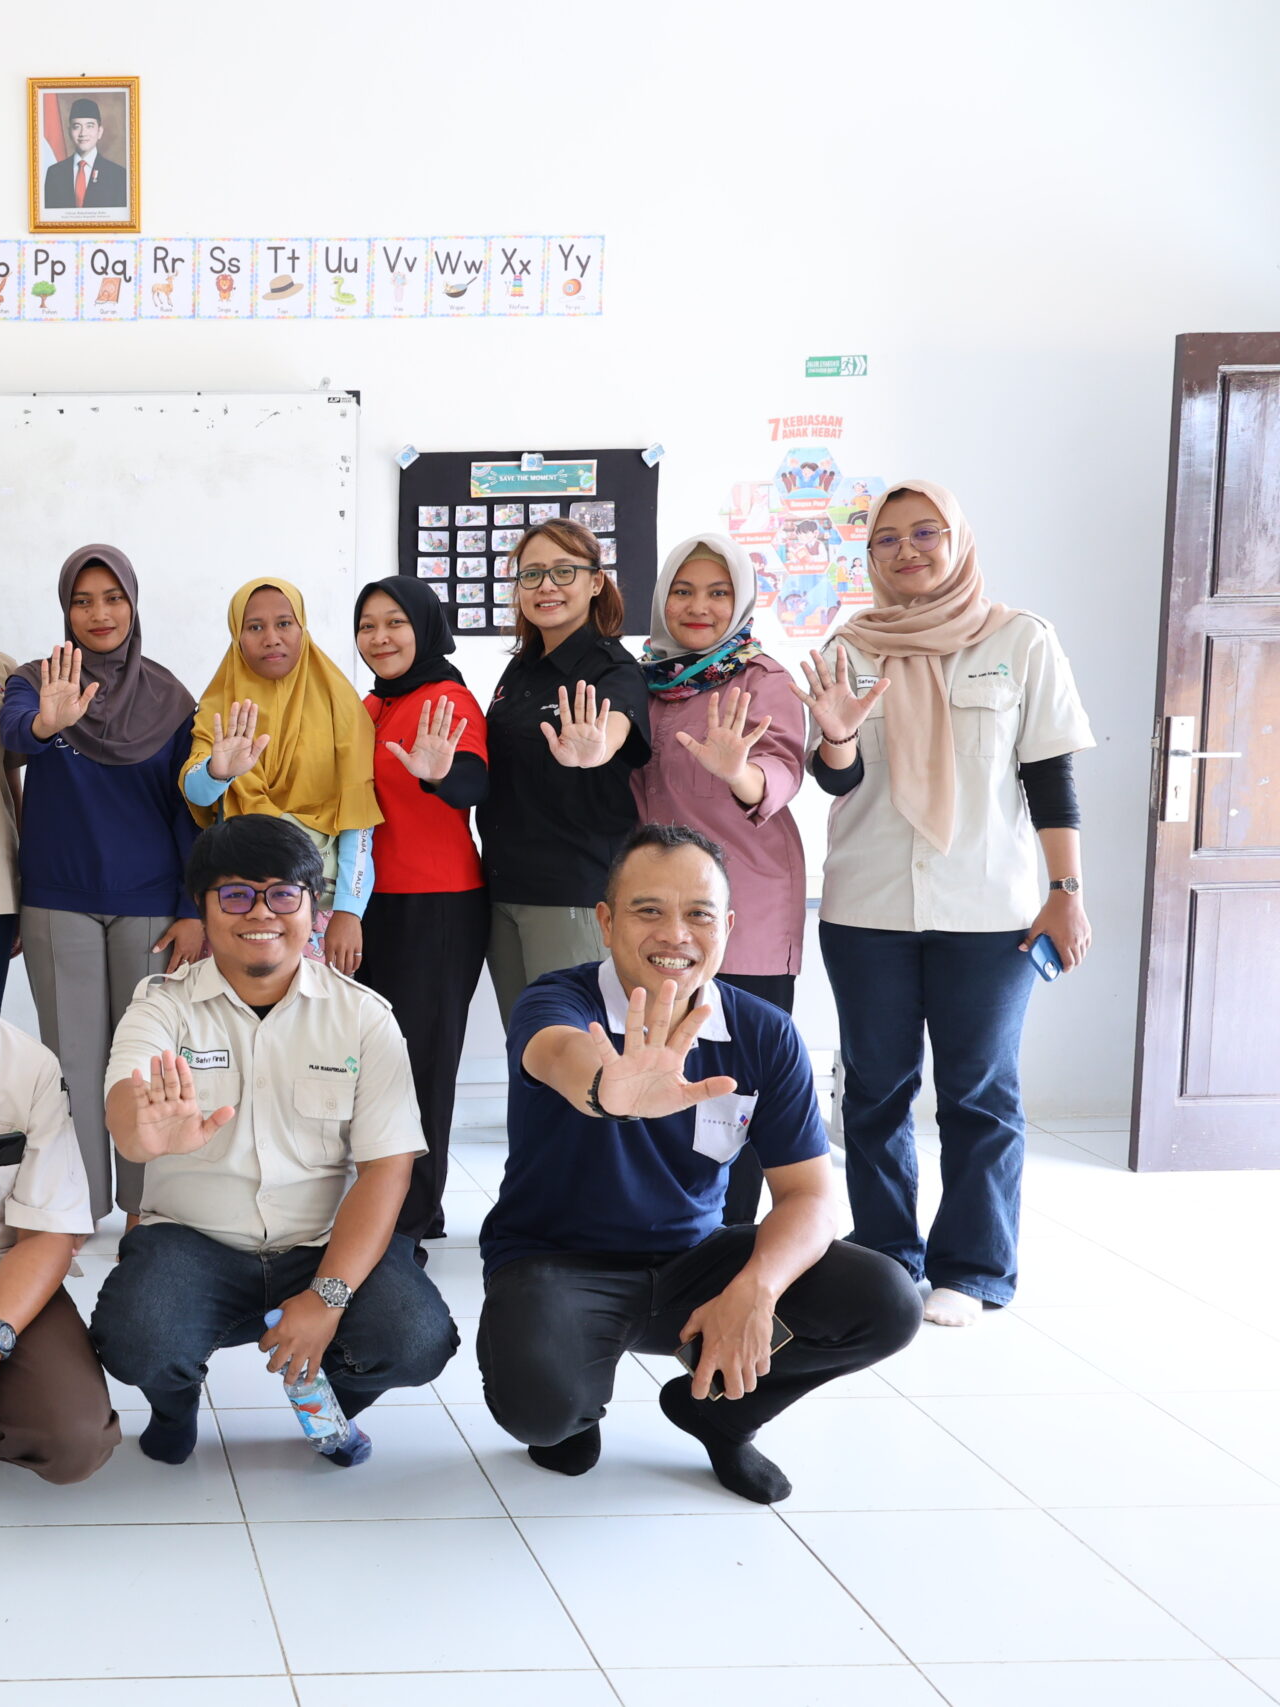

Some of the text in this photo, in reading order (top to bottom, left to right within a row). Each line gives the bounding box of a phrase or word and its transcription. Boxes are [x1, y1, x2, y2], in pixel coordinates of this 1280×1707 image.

[34, 249, 66, 283] Pp
[90, 248, 132, 283] Qq
[153, 246, 185, 274] Rr
[209, 246, 241, 274] Ss
[266, 246, 300, 273] Tt
[325, 246, 358, 274] Uu
[382, 246, 417, 273] Vv
[434, 250, 483, 275] Ww
[500, 248, 531, 275] Xx
[558, 244, 591, 278] Yy
[768, 418, 780, 441] 7
[783, 414, 843, 428] KEBIASAAN
[783, 428, 843, 439] ANAK HEBAT
